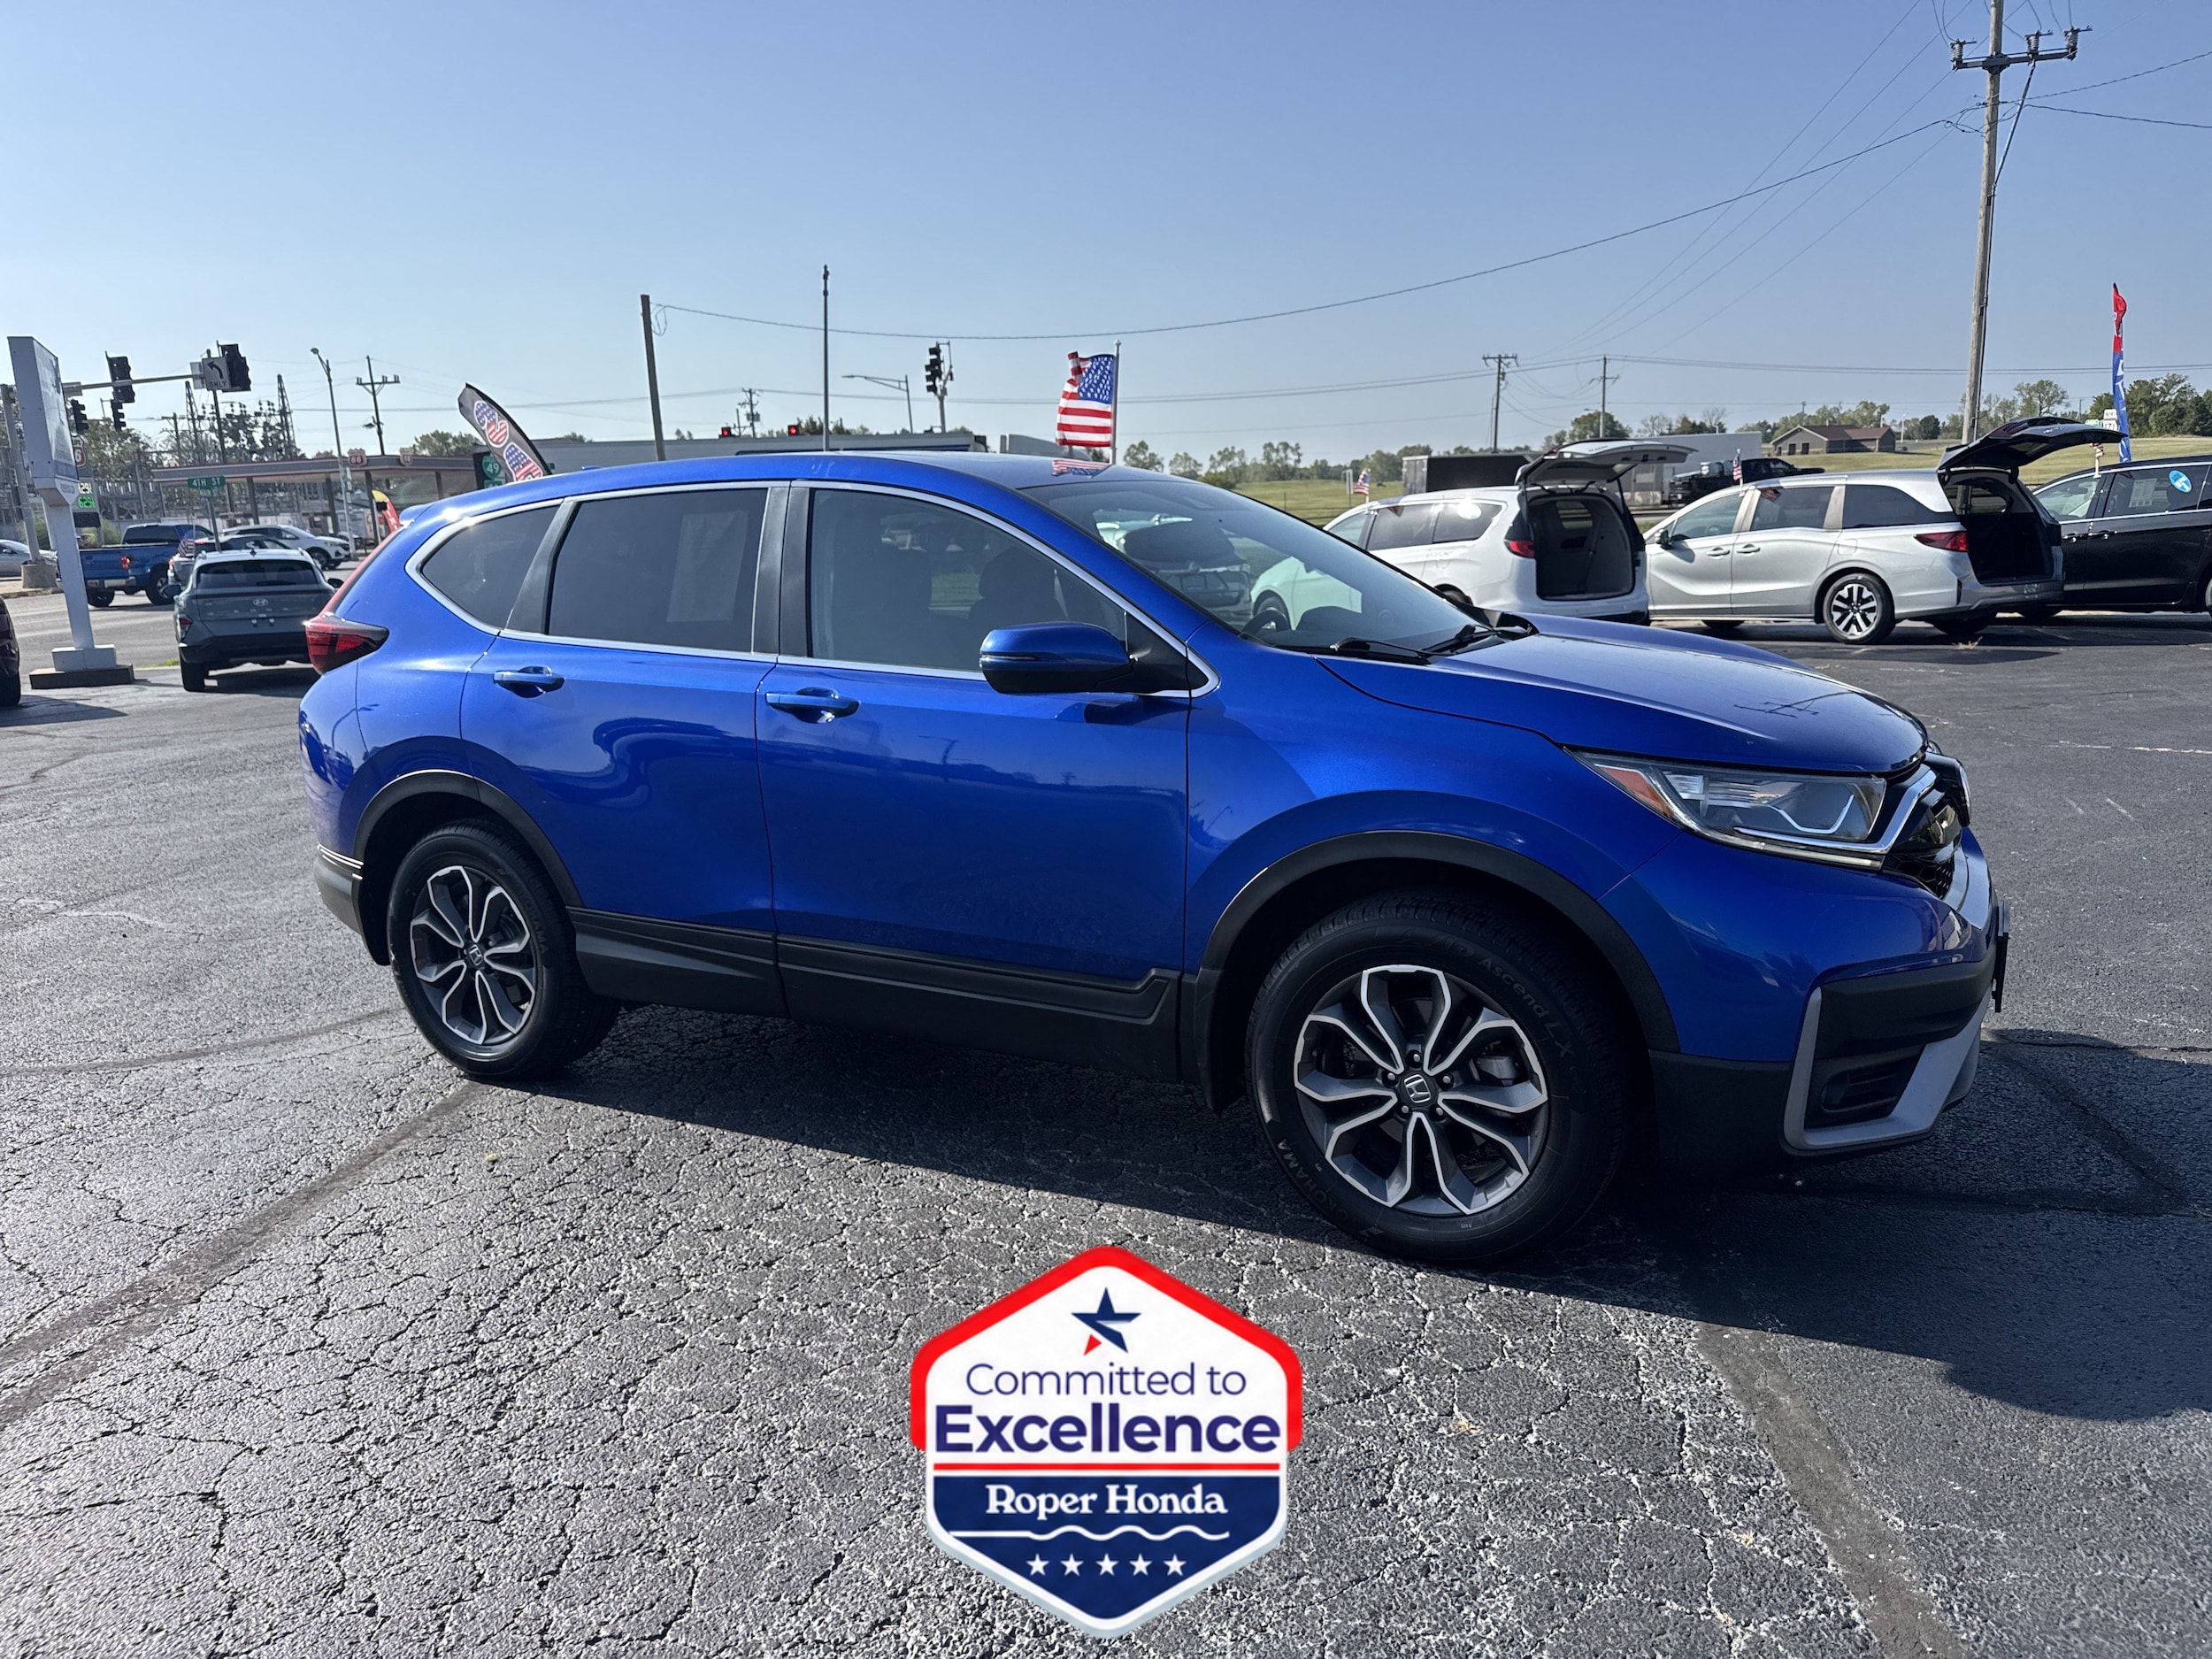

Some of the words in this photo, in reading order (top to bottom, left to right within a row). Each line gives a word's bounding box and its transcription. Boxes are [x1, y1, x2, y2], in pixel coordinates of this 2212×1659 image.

[209, 380, 227, 388] ONLY
[350, 455, 364, 465] 66
[487, 462, 500, 474] 49
[211, 477, 221, 487] ST
[1476, 957, 1550, 1018] Ascend
[1545, 1021, 1575, 1057] LX
[1277, 1138, 1358, 1226] OKOHAMA
